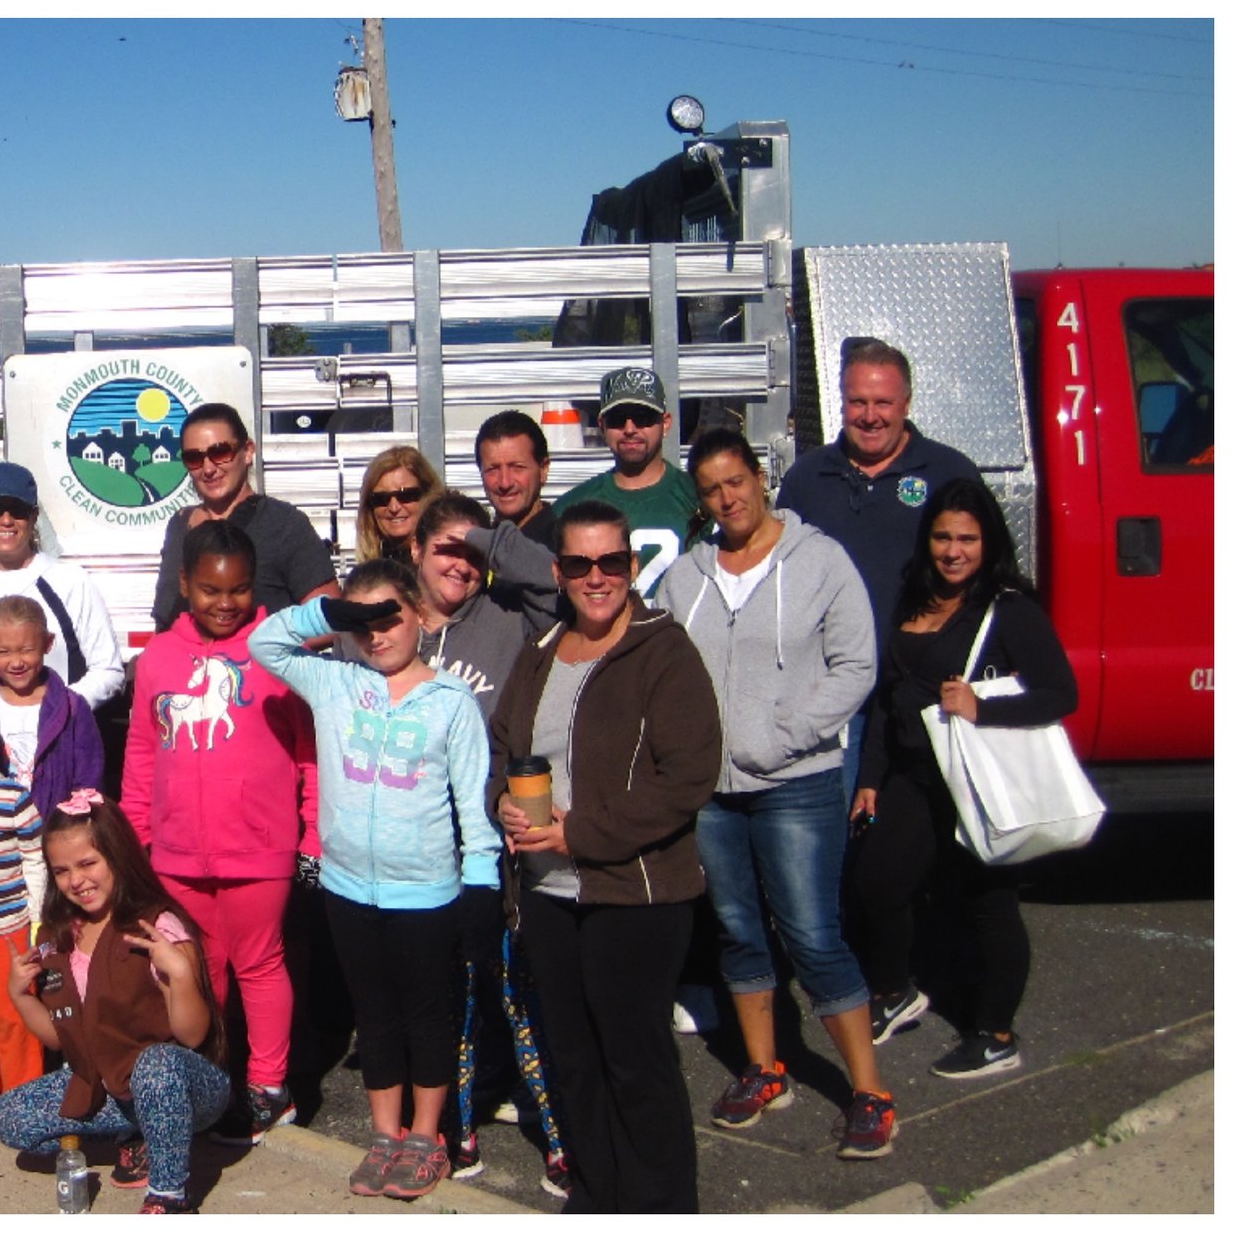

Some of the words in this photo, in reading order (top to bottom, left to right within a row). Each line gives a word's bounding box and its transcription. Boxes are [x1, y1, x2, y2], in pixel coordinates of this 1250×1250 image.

[56, 358, 141, 413] MONMOUTH
[145, 361, 205, 406] COUNTY
[59, 474, 104, 517] CLEAN
[429, 655, 495, 695] NAVY
